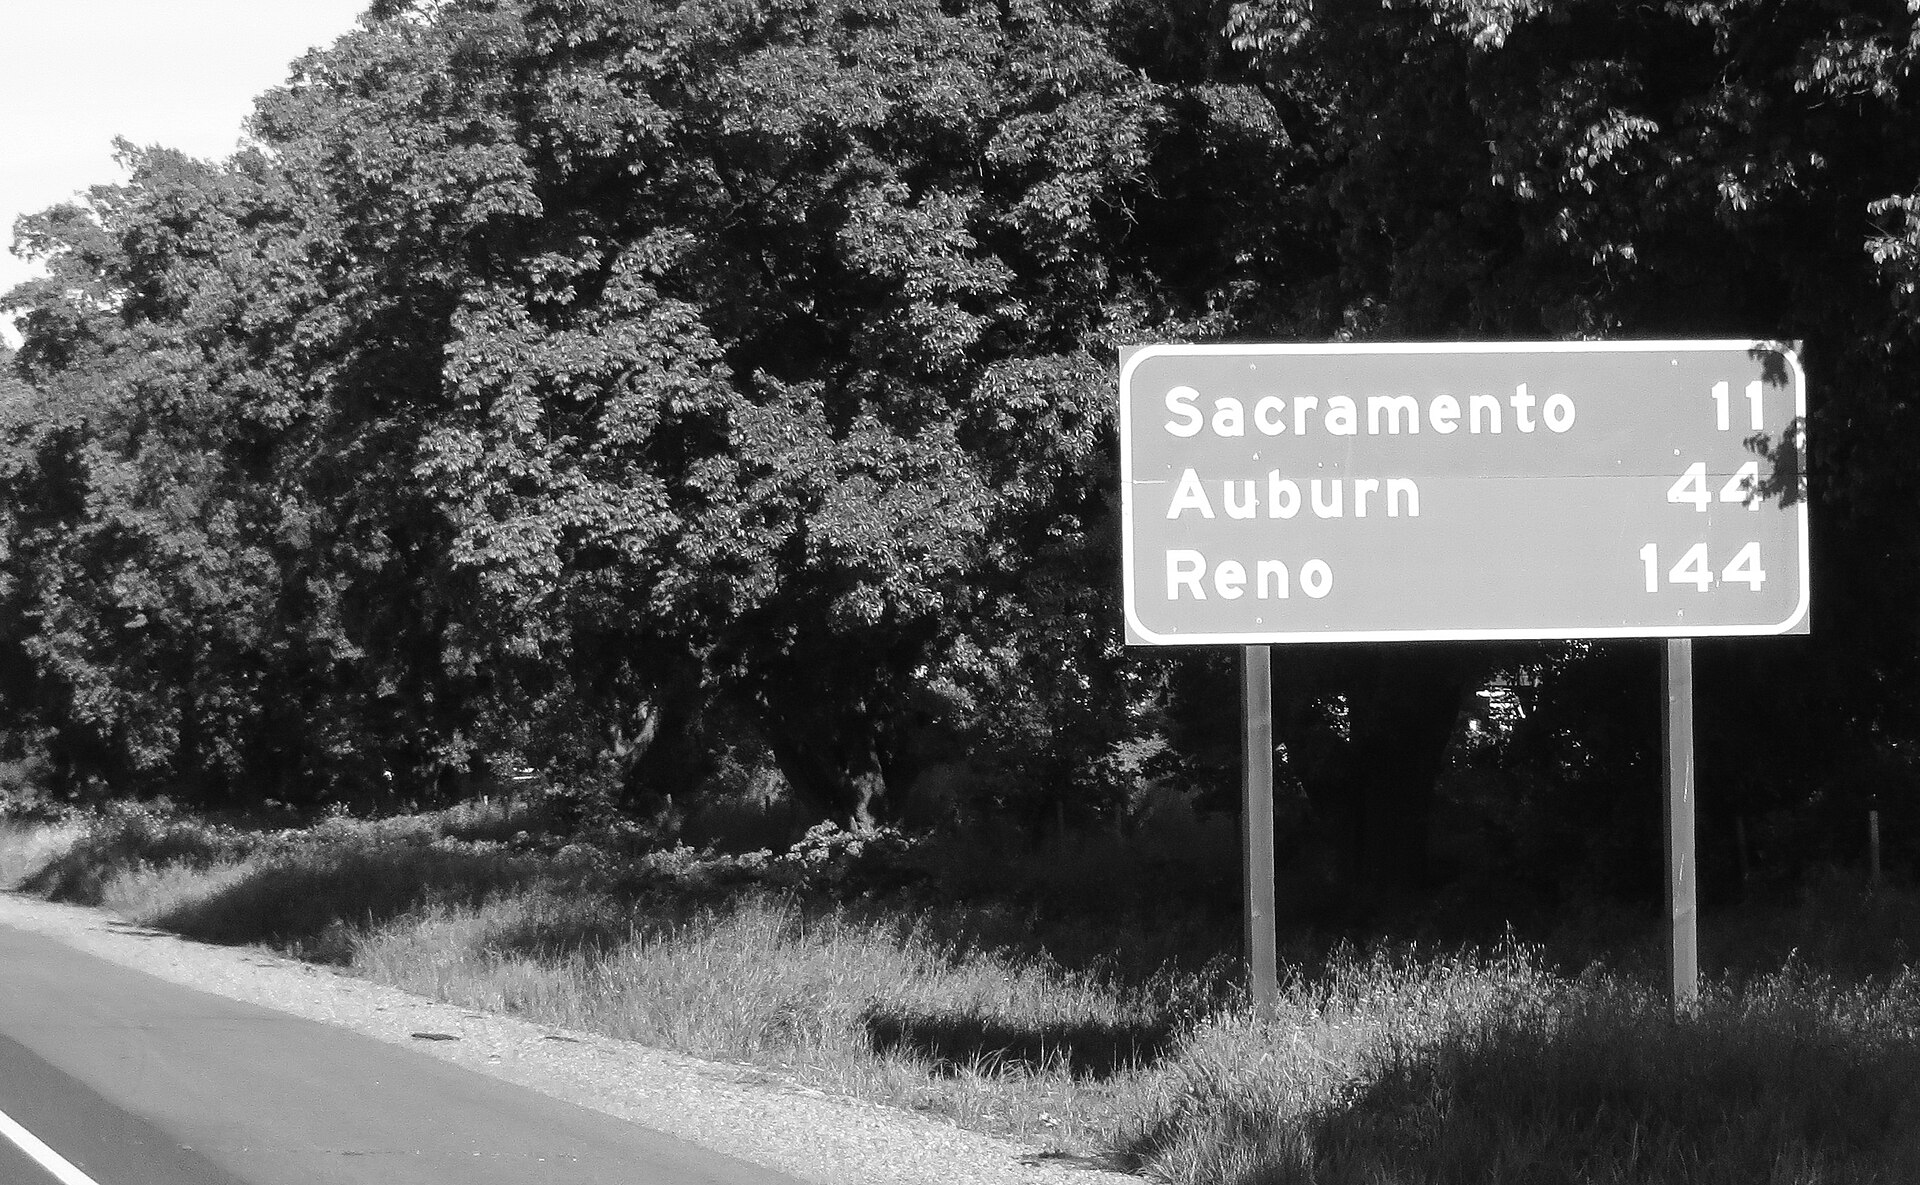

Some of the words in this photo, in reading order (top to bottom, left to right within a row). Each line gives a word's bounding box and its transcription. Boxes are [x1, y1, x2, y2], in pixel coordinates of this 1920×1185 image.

[1165, 383, 1575, 437] Sacramento
[1712, 381, 1763, 430] 11
[1167, 469, 1419, 519] Auburn
[1667, 462, 1763, 512] 44
[1166, 550, 1332, 600] Reno
[1640, 542, 1766, 592] 144
